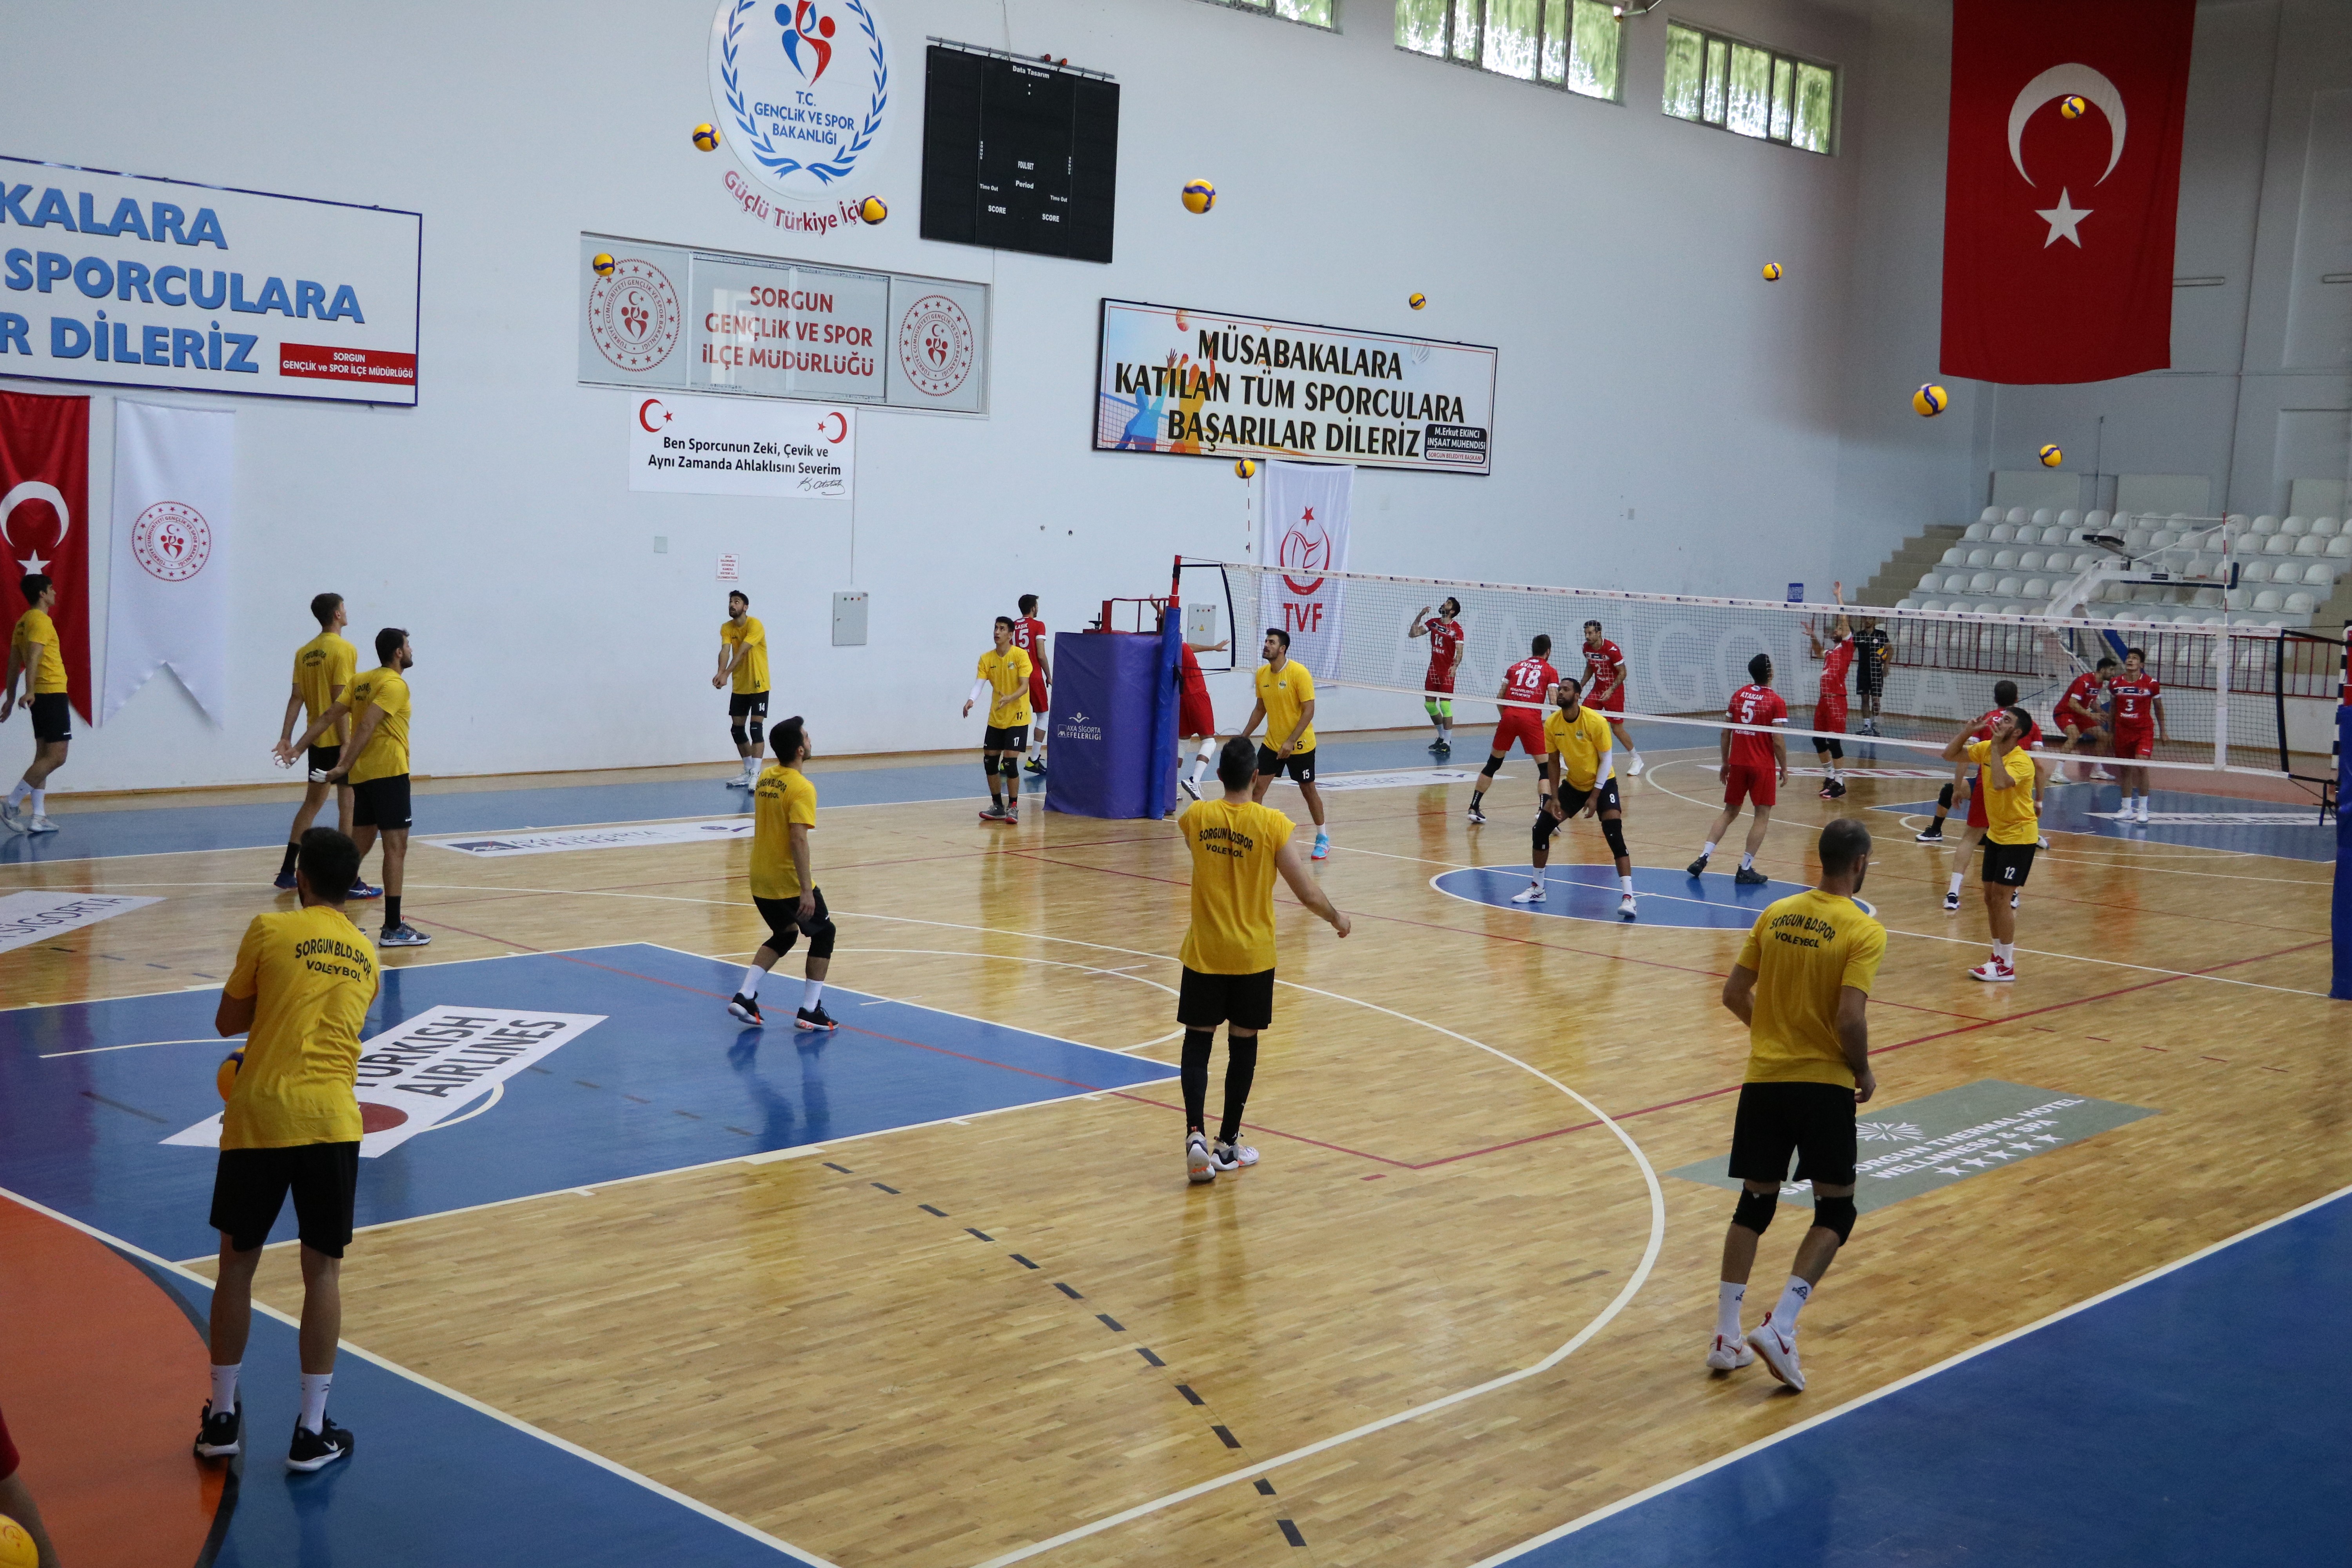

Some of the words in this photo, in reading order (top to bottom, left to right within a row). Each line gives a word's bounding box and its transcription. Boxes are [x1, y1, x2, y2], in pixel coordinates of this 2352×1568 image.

[1013, 65, 1026, 74] Data
[1027, 67, 1049, 79] Tasarım
[796, 91, 816, 106] T.C.
[755, 102, 806, 122] GENÇLİK
[808, 112, 822, 125] VE
[825, 116, 855, 131] SPOR
[773, 123, 837, 145] BAKANLIĞI
[1016, 180, 1034, 189] Period
[724, 170, 769, 220] Güçlü
[774, 207, 837, 236] Türkiye
[839, 199, 862, 226] İçi
[988, 205, 1006, 214] SCORE
[1042, 213, 1060, 222] SCORE
[5, 248, 365, 324] SPORCULARA
[606, 280, 627, 324] CUMHURİYETİ
[627, 280, 652, 292] GENÇLİK
[652, 290, 659, 299] VE
[750, 286, 833, 314] SORGUN
[931, 314, 951, 325] GENÇLİK
[705, 313, 790, 343] GENÇLİK
[795, 321, 820, 343] VE
[824, 325, 873, 347] SPOR
[51, 310, 259, 373] DİLERİZ
[334, 352, 365, 363] SORGUN
[702, 344, 744, 371] İLÇE
[749, 348, 874, 377] MÜDÜRLÜĞÜ
[1198, 324, 1403, 381] MÜSABAKALARA
[283, 360, 316, 372] GENÇLİK
[330, 364, 348, 373] SPOR
[351, 364, 367, 376] İLÇE
[369, 366, 413, 378] MÜDÜRLÜĞÜ
[1115, 362, 1230, 403] KATILAN
[1240, 368, 1294, 409] TÜM
[1305, 381, 1465, 424] SPORCULARA
[1167, 409, 1316, 452] BAŞARILAR
[1325, 416, 1421, 457] DİLERİZ
[1435, 426, 1459, 437] M.Erkut
[664, 437, 685, 450] Ben
[688, 438, 750, 454] Sporcunun
[753, 442, 780, 456] Zeki,
[784, 444, 814, 459] Çevik
[816, 448, 829, 457] ve
[1427, 437, 1450, 448] İNŞAAT
[1451, 439, 1486, 450] MÜHENDİSİ
[648, 454, 675, 470] Aynı
[678, 456, 732, 470] Zamanda
[735, 459, 795, 474] Ahlaklısını
[798, 463, 841, 475] Severim
[1283, 603, 1323, 632] TVF
[1011, 628, 1029, 648] 15
[1435, 633, 1443, 647] 14
[1515, 667, 1541, 688] 18
[1595, 664, 1602, 675] 2
[754, 680, 760, 689] 14
[1740, 691, 1764, 701] ATAKAN
[759, 702, 766, 712] 14
[1741, 700, 1756, 724] 5
[2125, 699, 2133, 712] 3
[1016, 711, 1023, 720] 17
[1078, 725, 1101, 733] SİGORTA
[1014, 737, 1019, 746] 17
[1302, 769, 1310, 779] 15
[1610, 793, 1615, 803] 8
[1199, 828, 1227, 842] SORGUN
[1206, 844, 1243, 858] VOLEYOL
[2004, 866, 2015, 879] 12
[1775, 931, 1819, 948] VOLEYBOL
[296, 938, 334, 959] SORGUN
[334, 942, 372, 980] BLD.SPOR
[306, 960, 361, 982] VOLEYBOL
[393, 1020, 567, 1097] AIRLINES
[2013, 1119, 2059, 1132] SPA
[1855, 1145, 1932, 1174] ORGUN
[1924, 1117, 2025, 1146] THERMAL
[2017, 1098, 2085, 1118] HOTEL
